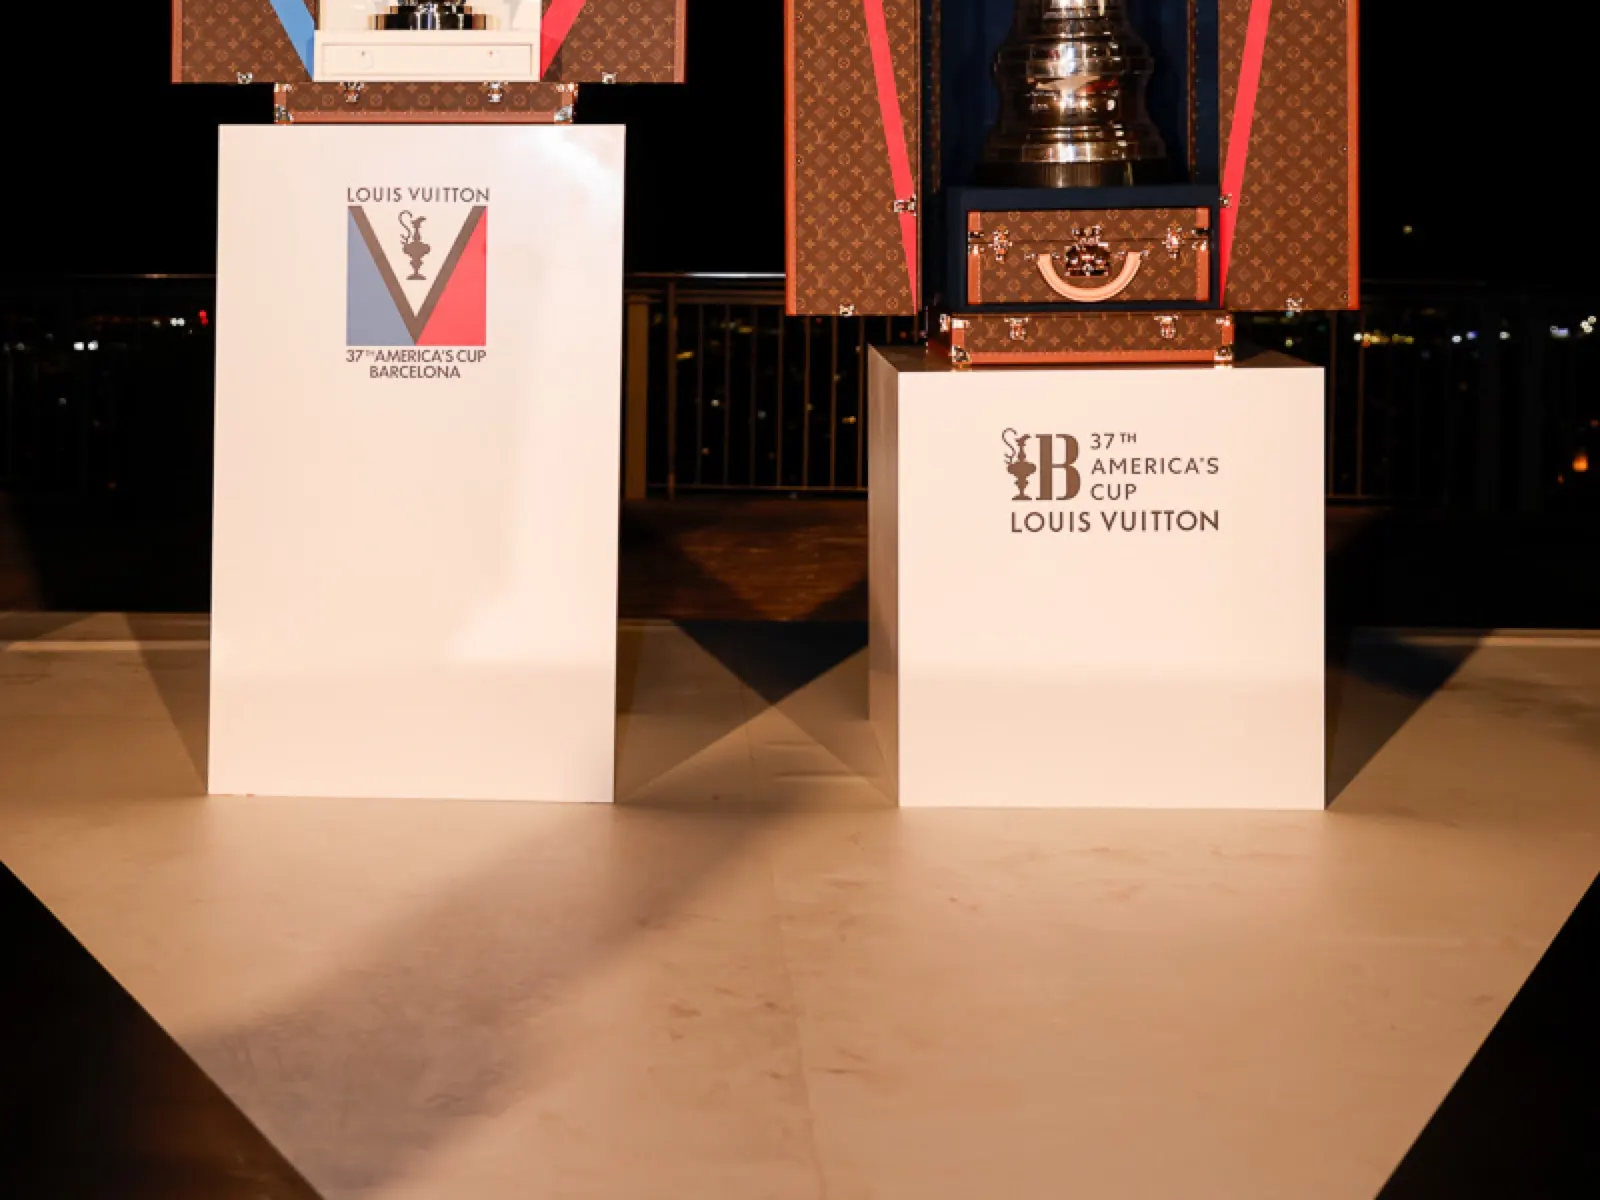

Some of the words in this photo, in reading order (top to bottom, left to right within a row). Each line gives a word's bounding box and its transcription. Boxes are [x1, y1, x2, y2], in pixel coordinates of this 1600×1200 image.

[347, 187, 402, 203] LOUIS
[408, 187, 490, 203] VUITTON
[374, 349, 454, 363] AMERICA'S
[456, 349, 487, 363] CUP
[369, 365, 461, 379] BARCELONA
[1091, 457, 1219, 475] AMERICA'S
[1090, 483, 1137, 501] CUP
[1011, 511, 1091, 533] LOUIS
[1100, 509, 1219, 532] VUITTON
